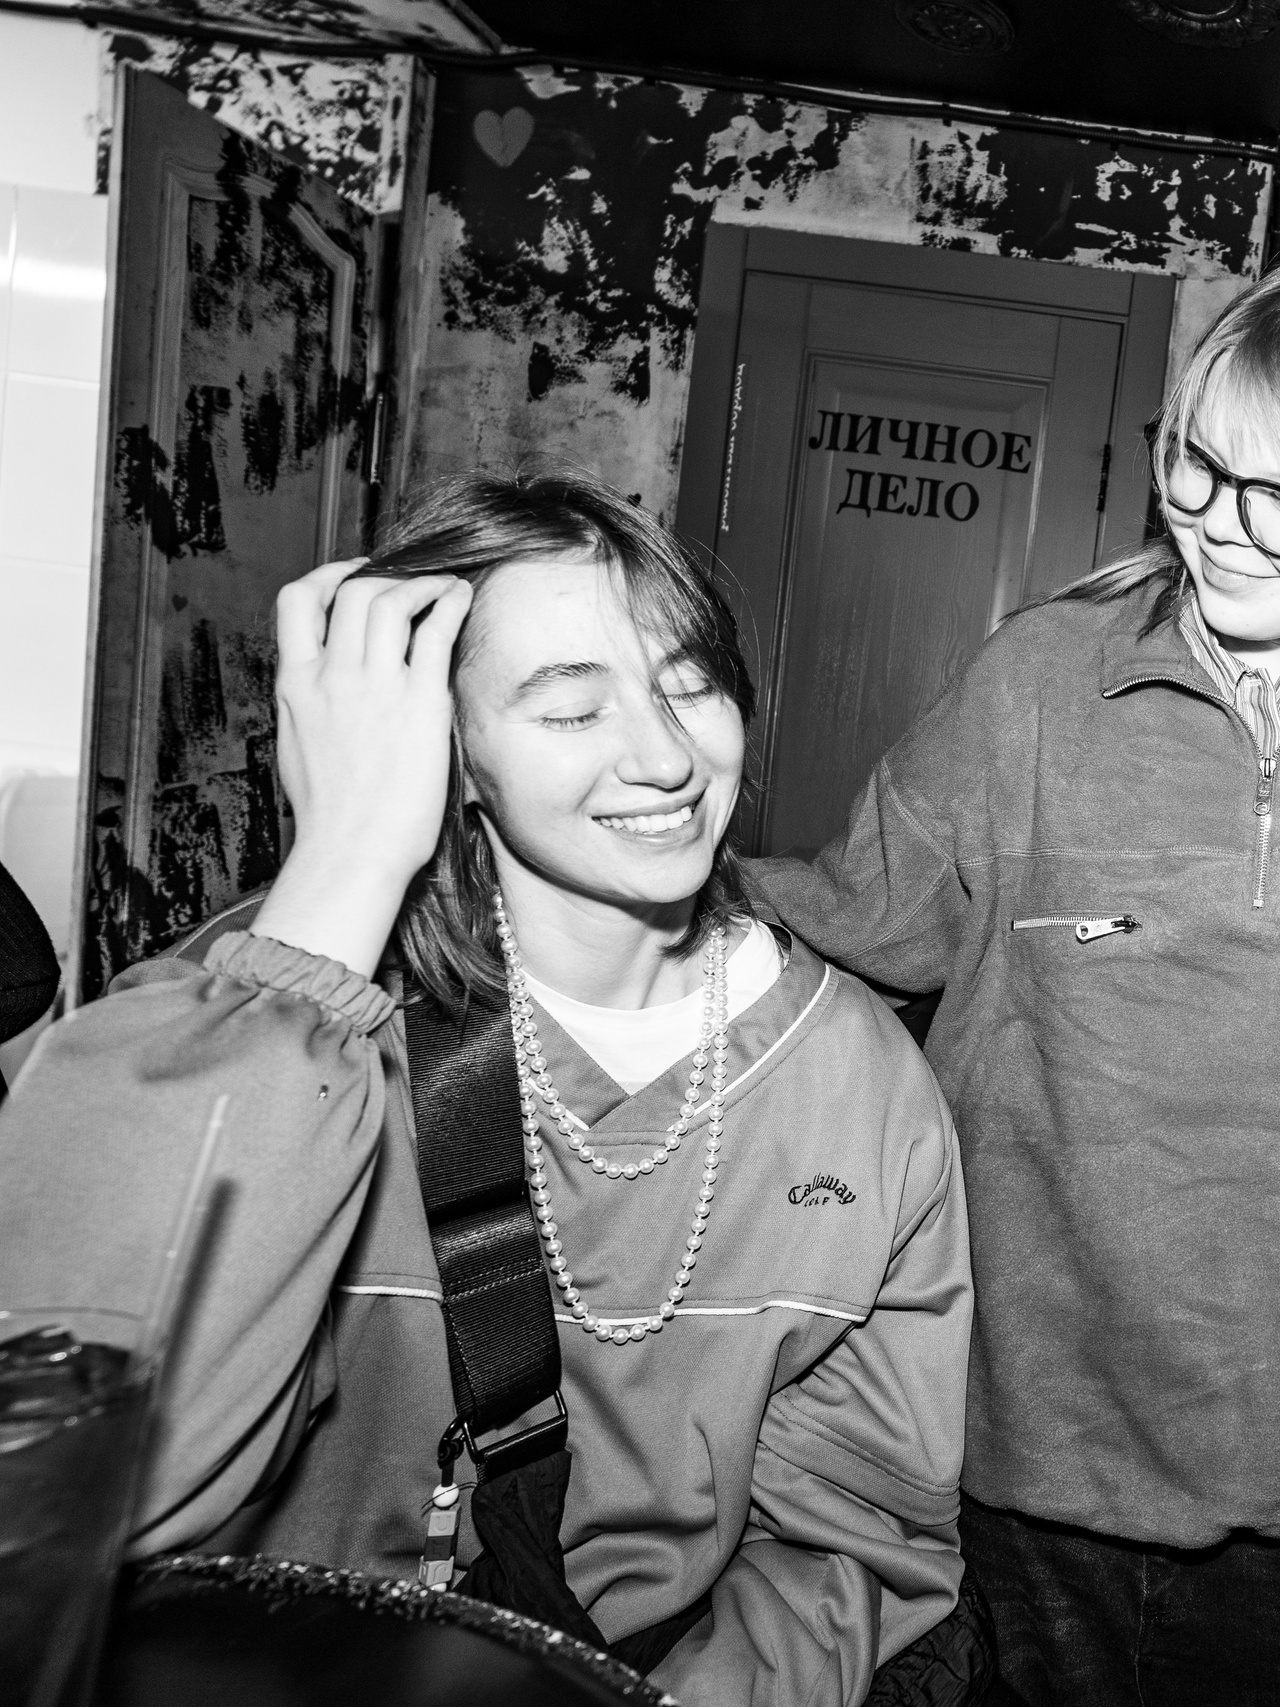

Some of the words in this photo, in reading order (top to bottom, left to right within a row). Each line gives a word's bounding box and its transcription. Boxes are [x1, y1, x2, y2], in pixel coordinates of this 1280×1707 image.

[808, 409, 1032, 474] ЛИЧНОЕ
[836, 468, 980, 522] ДЕЛО
[788, 1172, 857, 1205] Callaway
